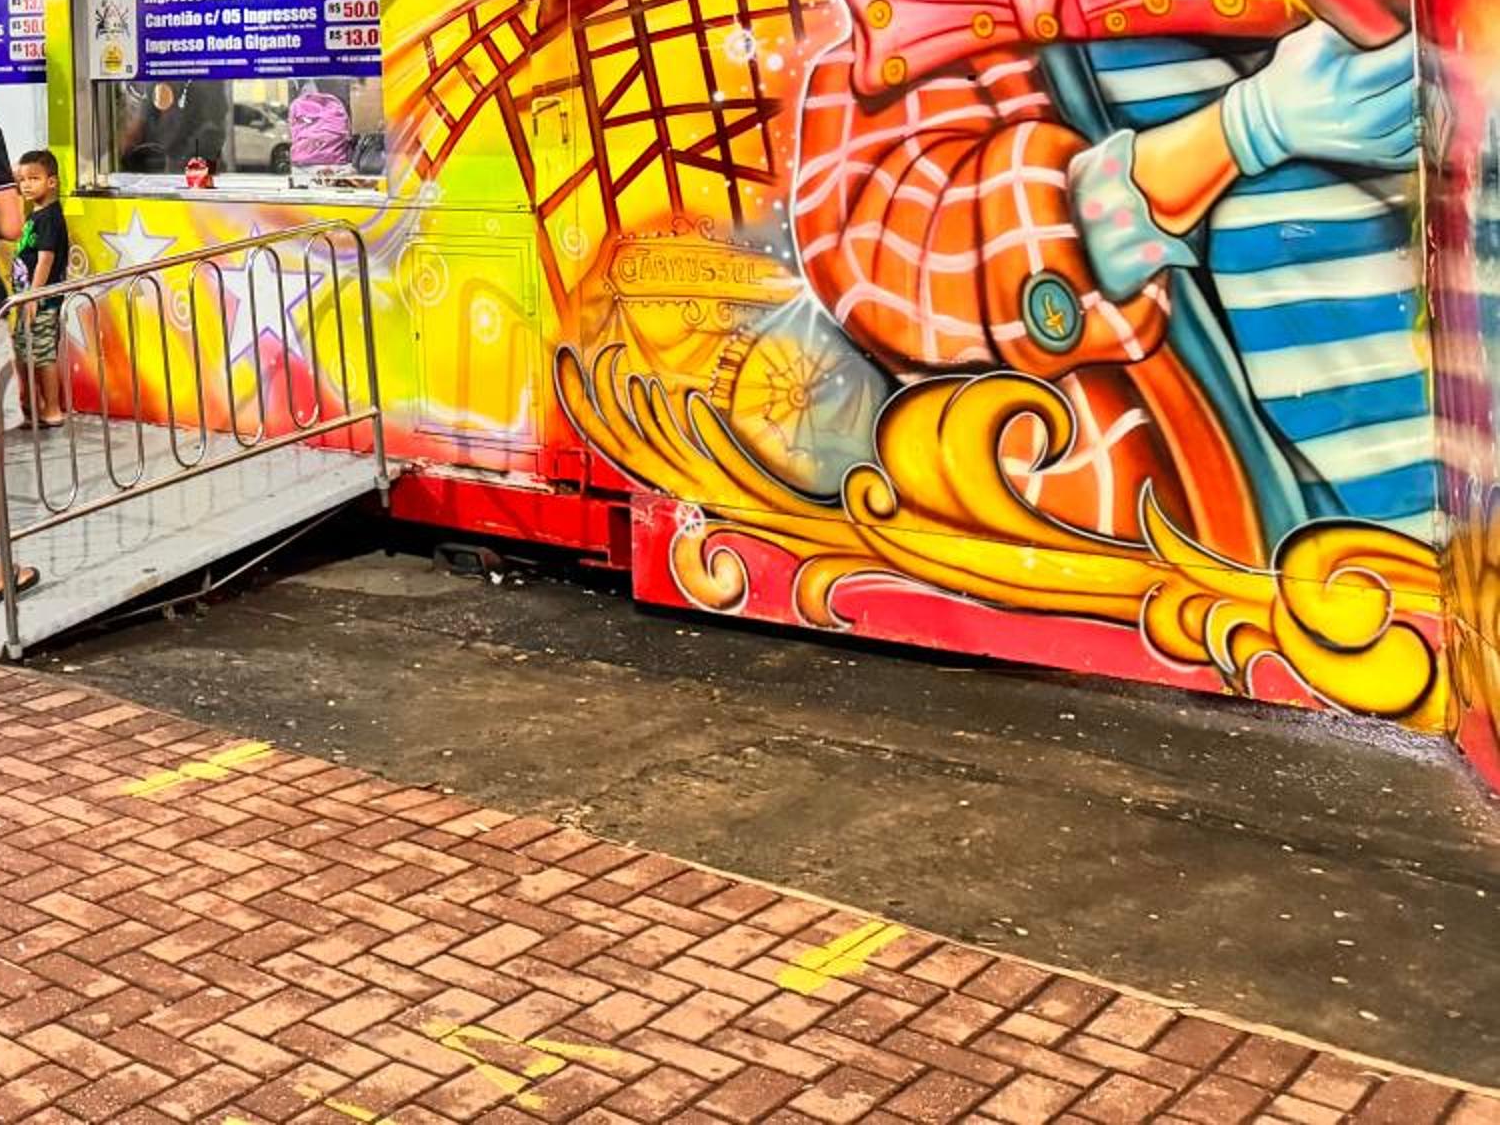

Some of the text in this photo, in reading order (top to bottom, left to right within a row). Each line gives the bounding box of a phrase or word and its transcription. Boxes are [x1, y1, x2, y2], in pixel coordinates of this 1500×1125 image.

[145, 11, 203, 28] Cartelão
[222, 8, 241, 24] 05
[244, 6, 317, 25] Ingressos
[145, 32, 301, 54] Ingresso Roda Gigante
